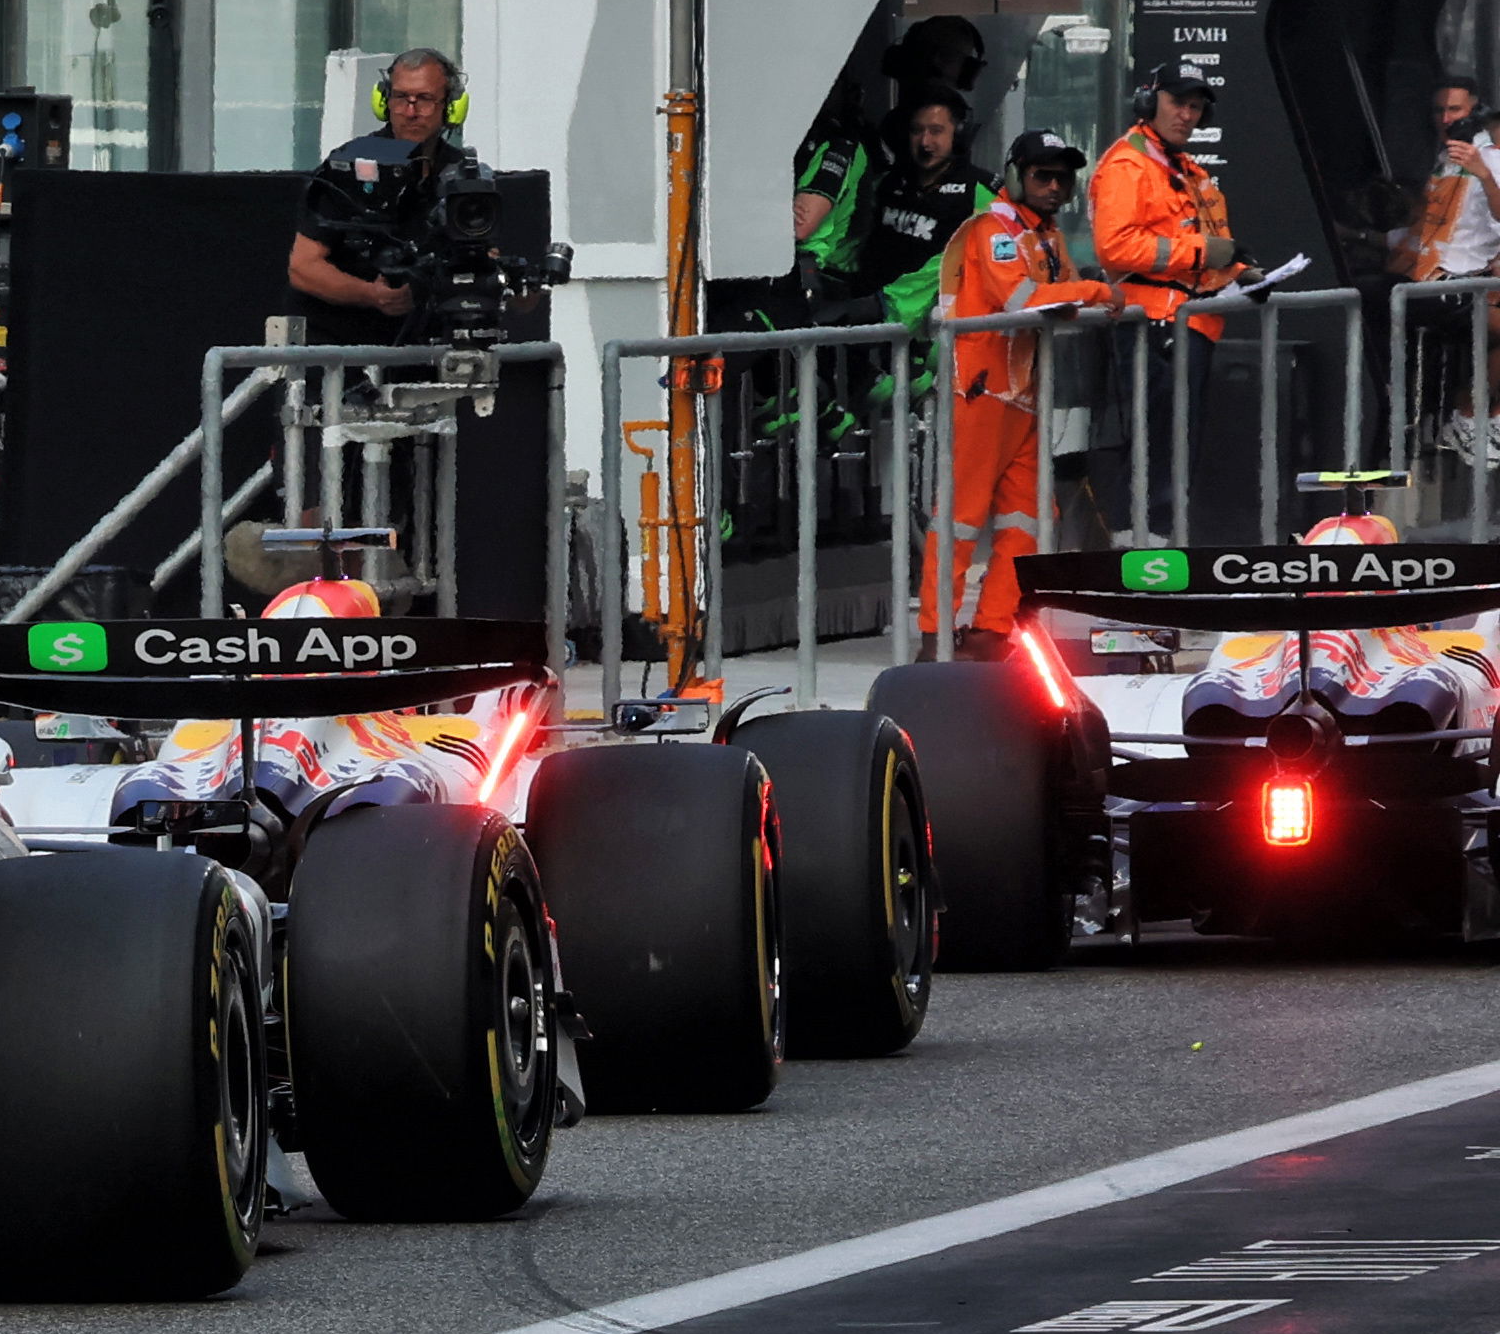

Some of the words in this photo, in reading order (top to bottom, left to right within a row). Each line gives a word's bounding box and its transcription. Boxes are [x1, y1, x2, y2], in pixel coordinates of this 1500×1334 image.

[1174, 26, 1227, 44] LVMH
[1211, 552, 1339, 586] Cash
[1351, 554, 1457, 590] App
[134, 626, 281, 665] Cash
[295, 628, 417, 669] App
